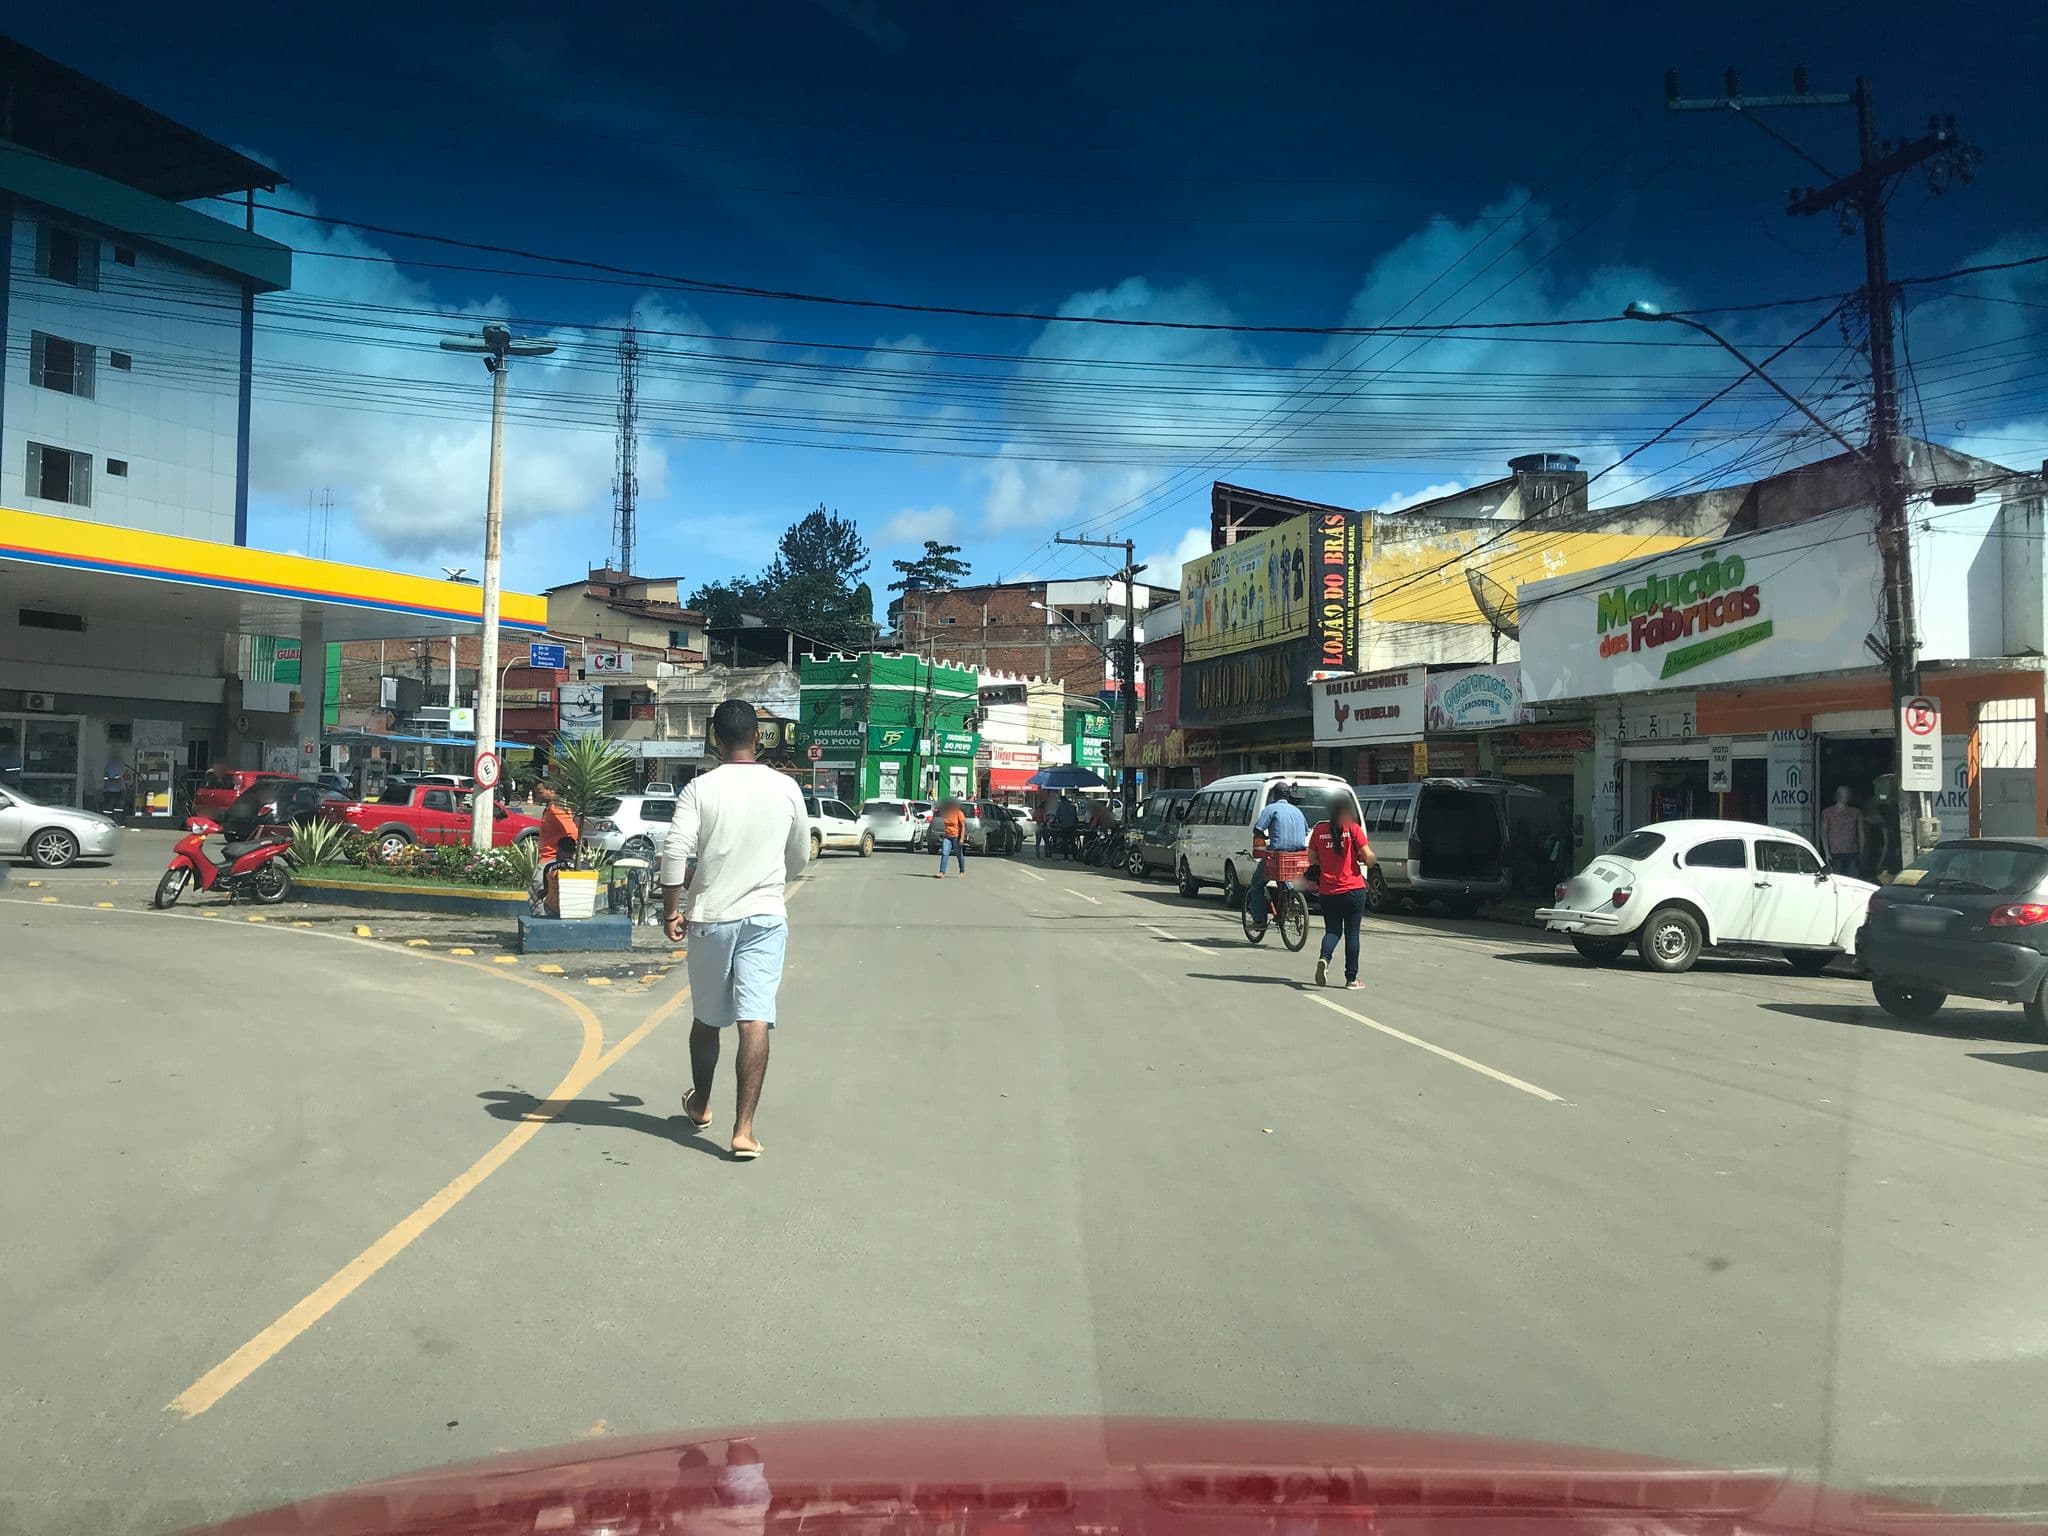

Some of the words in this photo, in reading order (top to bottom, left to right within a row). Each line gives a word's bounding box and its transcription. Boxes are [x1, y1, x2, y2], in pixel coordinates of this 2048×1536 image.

[1317, 514, 1345, 566] BRÁS
[1323, 573, 1344, 600] DO
[1316, 604, 1344, 665] LOJÃO
[1600, 633, 1629, 659] das
[1630, 585, 1760, 652] Fábricas
[1326, 683, 1342, 696] BAR
[1351, 672, 1409, 692] LANCHONETE
[1354, 705, 1400, 721] VERMELHO
[1461, 699, 1495, 712] LANCHONETE
[813, 727, 859, 737] FARMÁCIA
